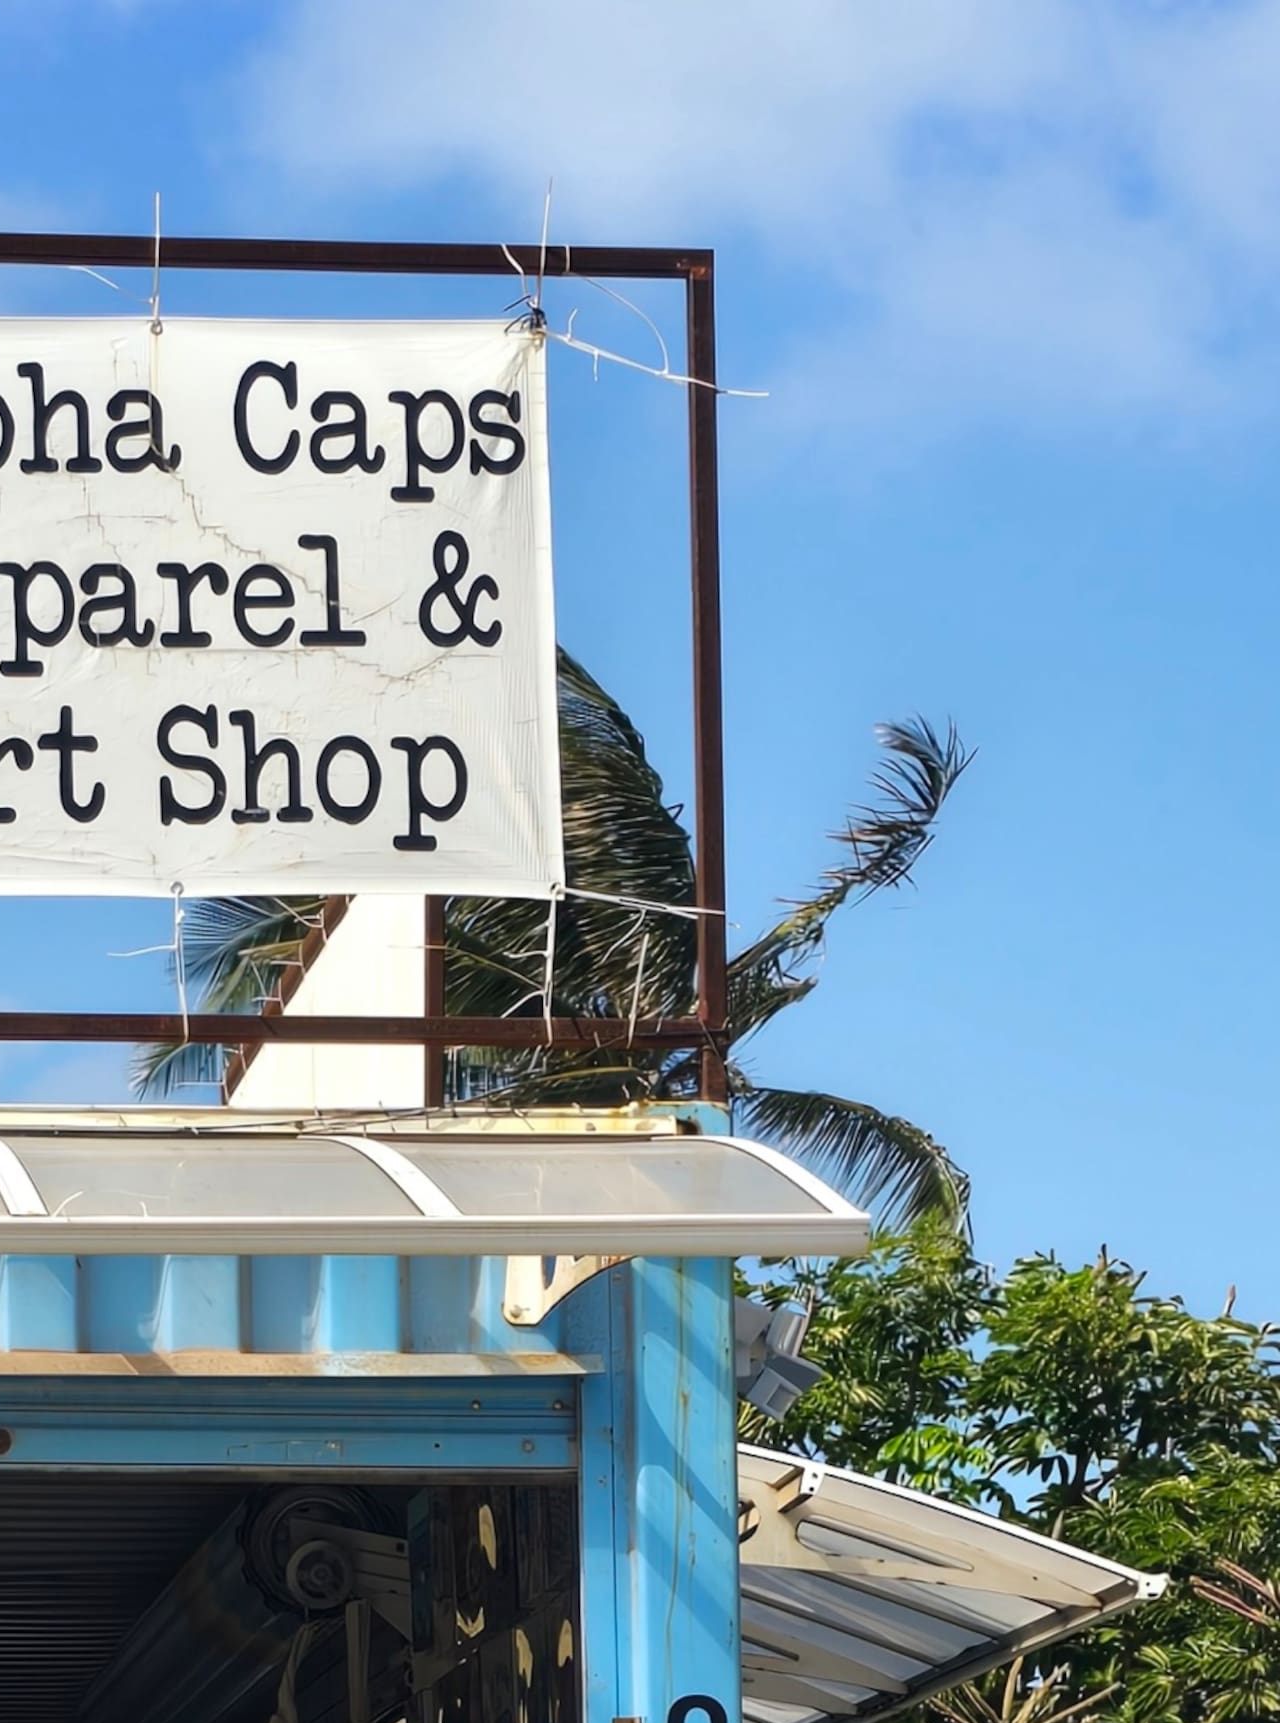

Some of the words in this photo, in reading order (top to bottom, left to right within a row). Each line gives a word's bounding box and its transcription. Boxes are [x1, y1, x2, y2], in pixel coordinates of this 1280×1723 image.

[233, 360, 525, 503] Caps
[418, 530, 502, 648] &
[156, 704, 468, 852] Shop
